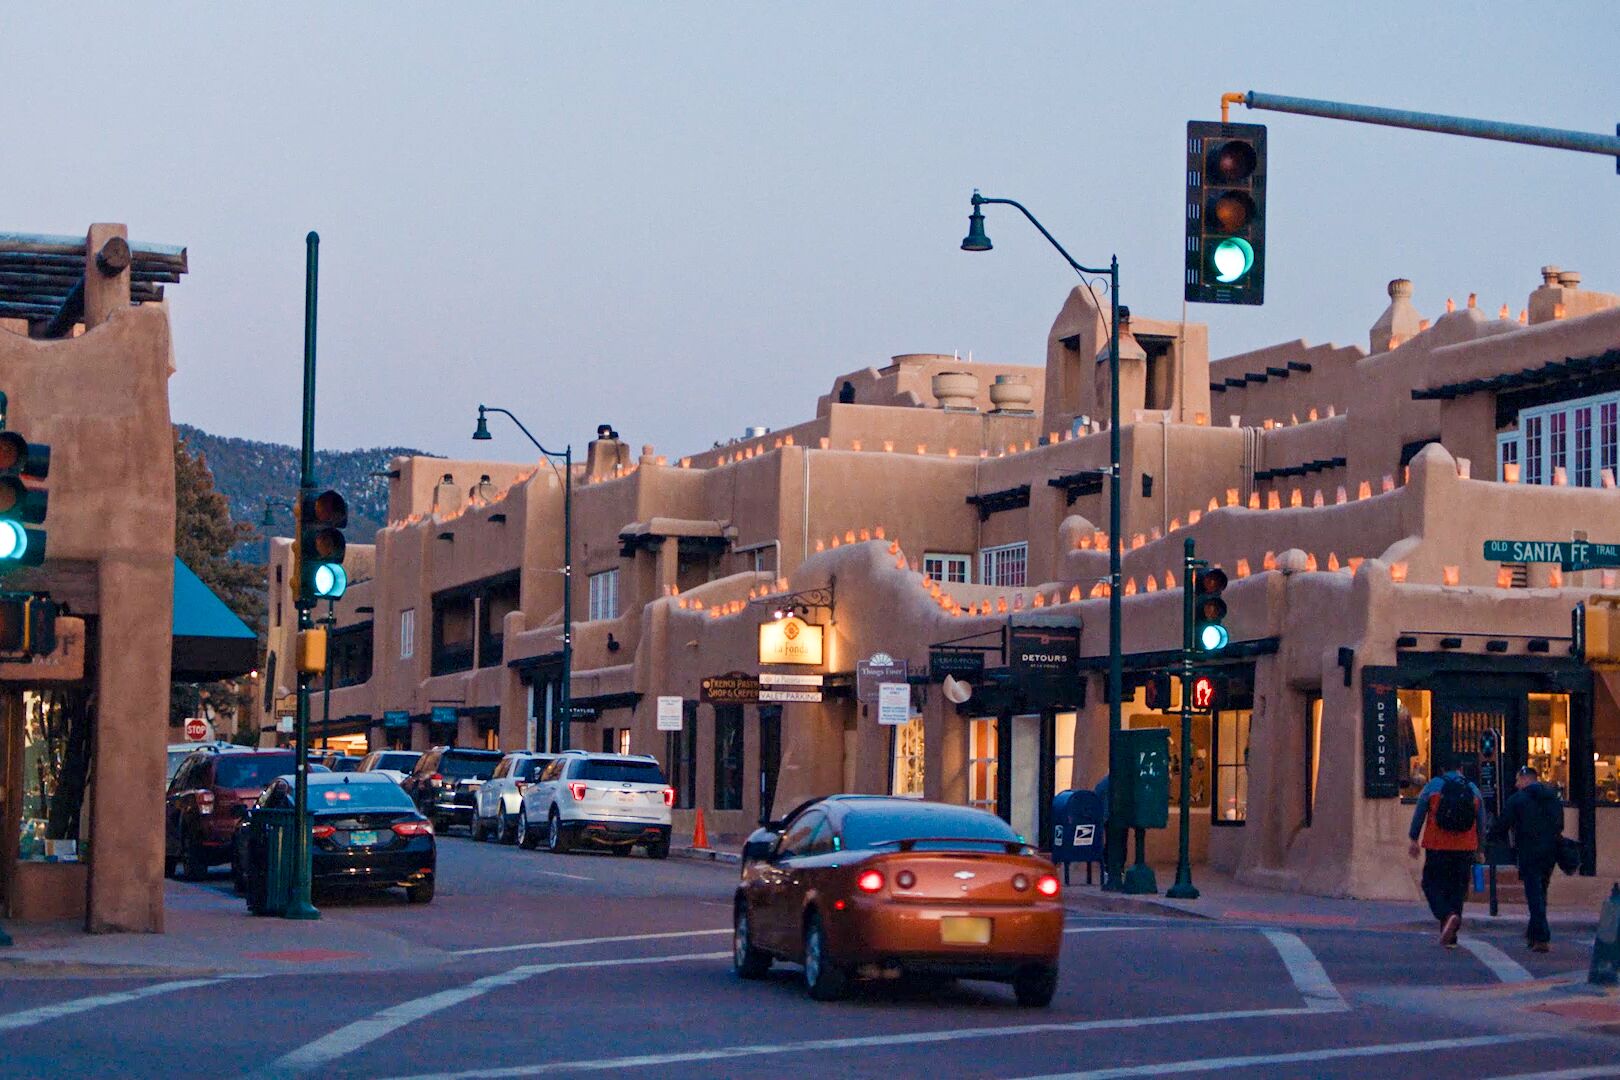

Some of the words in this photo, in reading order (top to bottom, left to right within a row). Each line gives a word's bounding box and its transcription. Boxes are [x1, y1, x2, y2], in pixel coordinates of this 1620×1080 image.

[1491, 541, 1508, 552] OLD
[1513, 542, 1563, 561] SANTA
[1571, 544, 1590, 562] FE
[1596, 545, 1618, 556] TRAIL
[785, 640, 809, 656] Fonda
[1021, 654, 1068, 662] DETOURS
[860, 667, 885, 677] Things
[709, 678, 736, 688] FRENCH
[760, 691, 785, 700] VALET
[786, 692, 820, 702] PARKING
[187, 725, 206, 735] STOP
[1377, 702, 1386, 776] DETOURS
